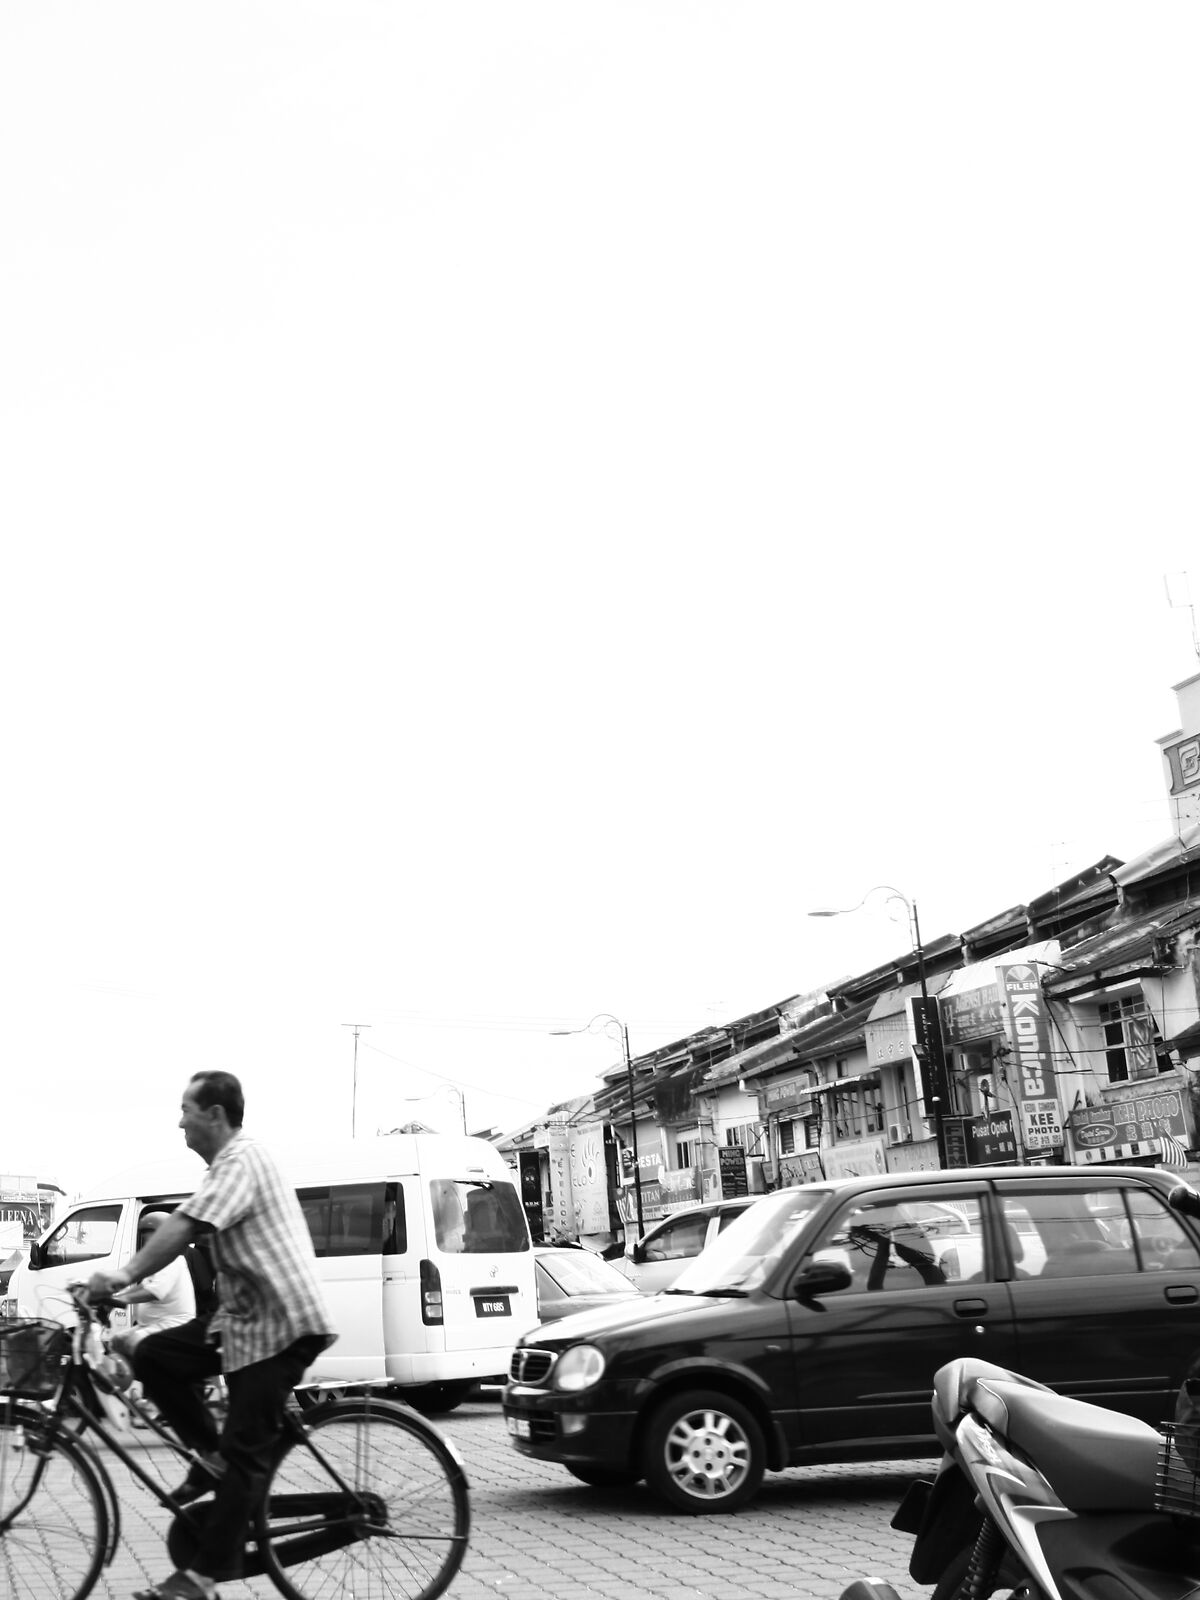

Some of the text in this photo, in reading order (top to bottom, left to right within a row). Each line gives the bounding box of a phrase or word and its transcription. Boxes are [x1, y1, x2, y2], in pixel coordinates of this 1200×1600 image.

[1006, 981, 1040, 992] FILEM
[1011, 993, 1046, 1096] Konica
[1136, 1095, 1179, 1121] PHOTO
[1030, 1112, 1054, 1126] KEE
[972, 1124, 989, 1138] Pusat
[990, 1121, 1007, 1137] Optik
[1028, 1126, 1060, 1135] PHOTO
[720, 1157, 744, 1166] POWER
[641, 1188, 661, 1203] TITAN
